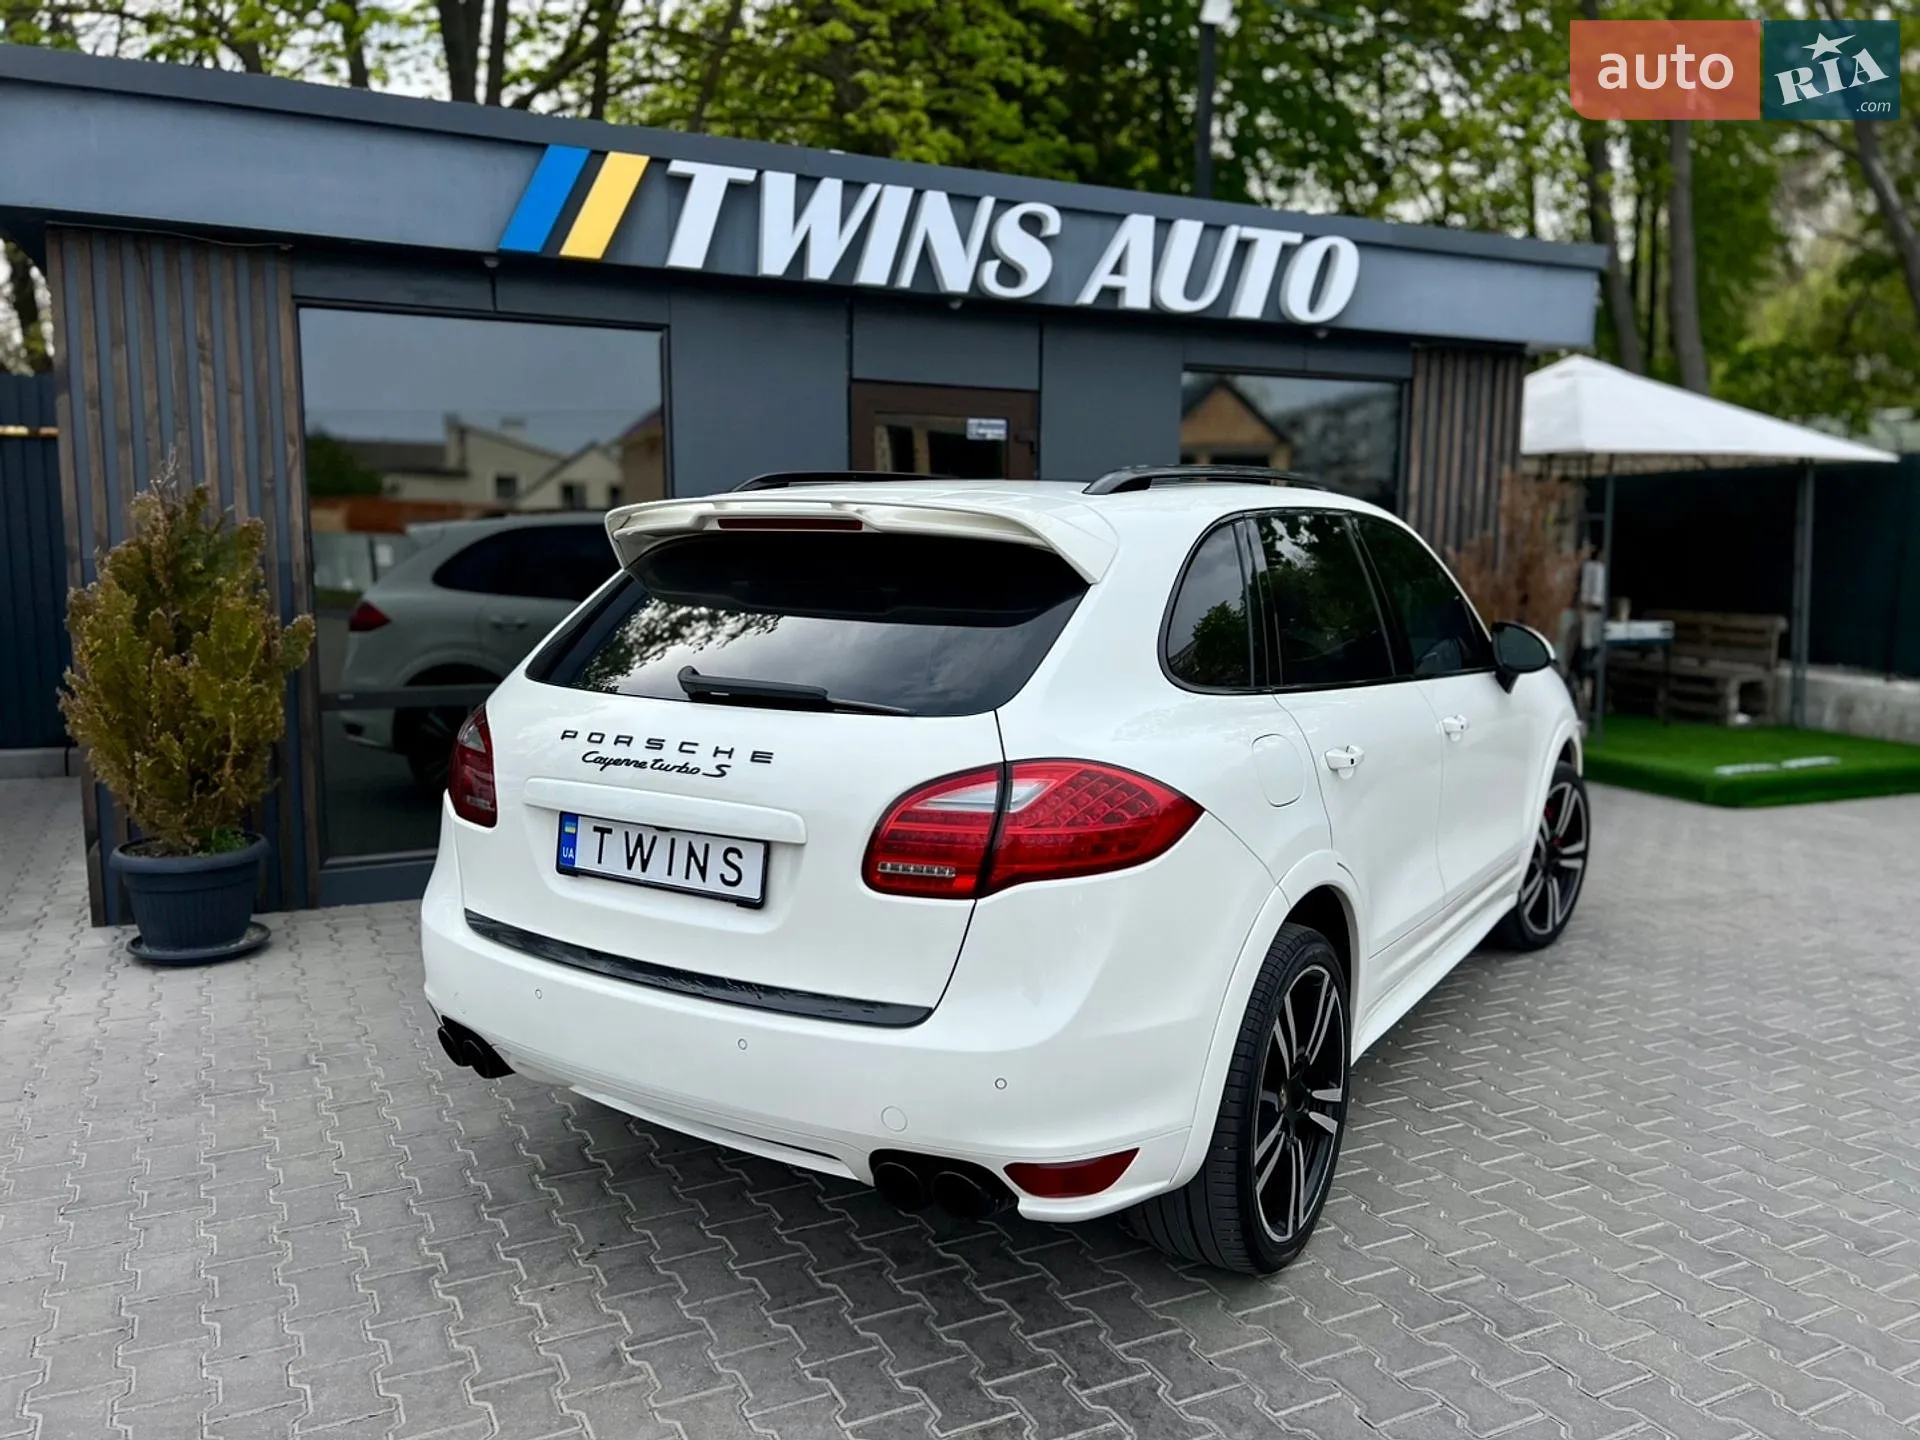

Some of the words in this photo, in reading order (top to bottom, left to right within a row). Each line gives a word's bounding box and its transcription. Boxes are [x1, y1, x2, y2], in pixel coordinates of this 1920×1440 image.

[665, 159, 1062, 298] TWINS
[1075, 213, 1360, 324] AUTO
[560, 730, 774, 764] PORSCHE
[581, 751, 648, 771] Cayenne
[650, 758, 701, 775] turbo
[702, 764, 732, 778] S
[562, 846, 575, 859] UA
[593, 825, 743, 887] TWINS
